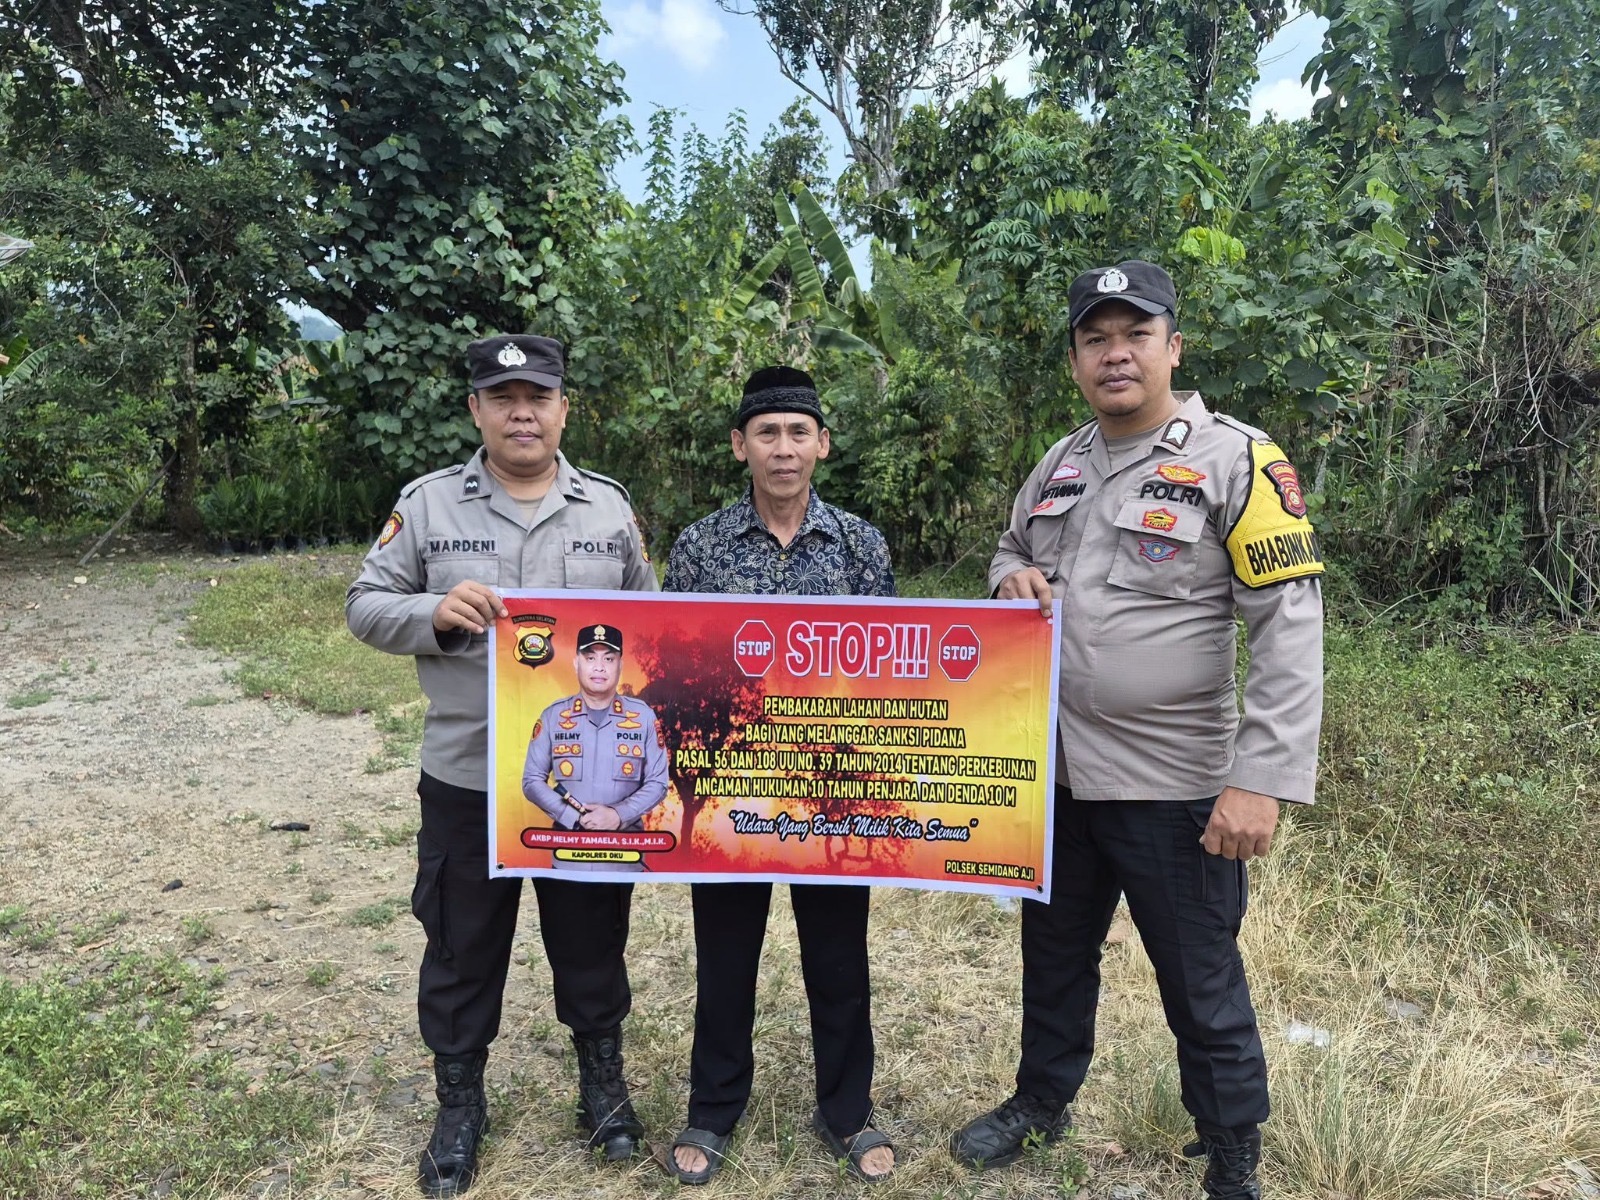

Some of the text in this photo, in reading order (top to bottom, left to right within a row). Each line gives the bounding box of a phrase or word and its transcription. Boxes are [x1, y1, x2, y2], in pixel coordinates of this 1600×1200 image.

[1140, 483, 1203, 507] POLRI
[430, 539, 496, 554] MARDENI
[572, 541, 617, 555] POLRI
[738, 641, 771, 656] STOP
[785, 620, 931, 679] STOP!!!
[942, 645, 976, 660] STOP
[764, 697, 948, 720] PEMBAKARAN LAHAN DAN HUTAN
[555, 732, 581, 740] HELMY
[616, 732, 642, 741] POLRI
[745, 723, 966, 748] BAGI YANG MELANGGAR SANKSI PIDANA
[675, 750, 1036, 781] PASAL 56 DAN 108 UU NO. 39 TAHUN 2014 TENTANG PERKEBUNAN
[693, 777, 1016, 807] ANCAMAN HUKUMAN 10 TAHUN PENJARA DAN DENDA 10 M
[776, 811, 810, 841] Yang
[812, 814, 851, 836] Bersih
[853, 815, 889, 837] Milik
[892, 816, 922, 839] Kita
[530, 834, 552, 842] AKBP
[553, 835, 579, 843] HELMY
[571, 851, 607, 859] KAPOLRES
[945, 860, 1035, 881] POLSEK SEMIDANG AJI
